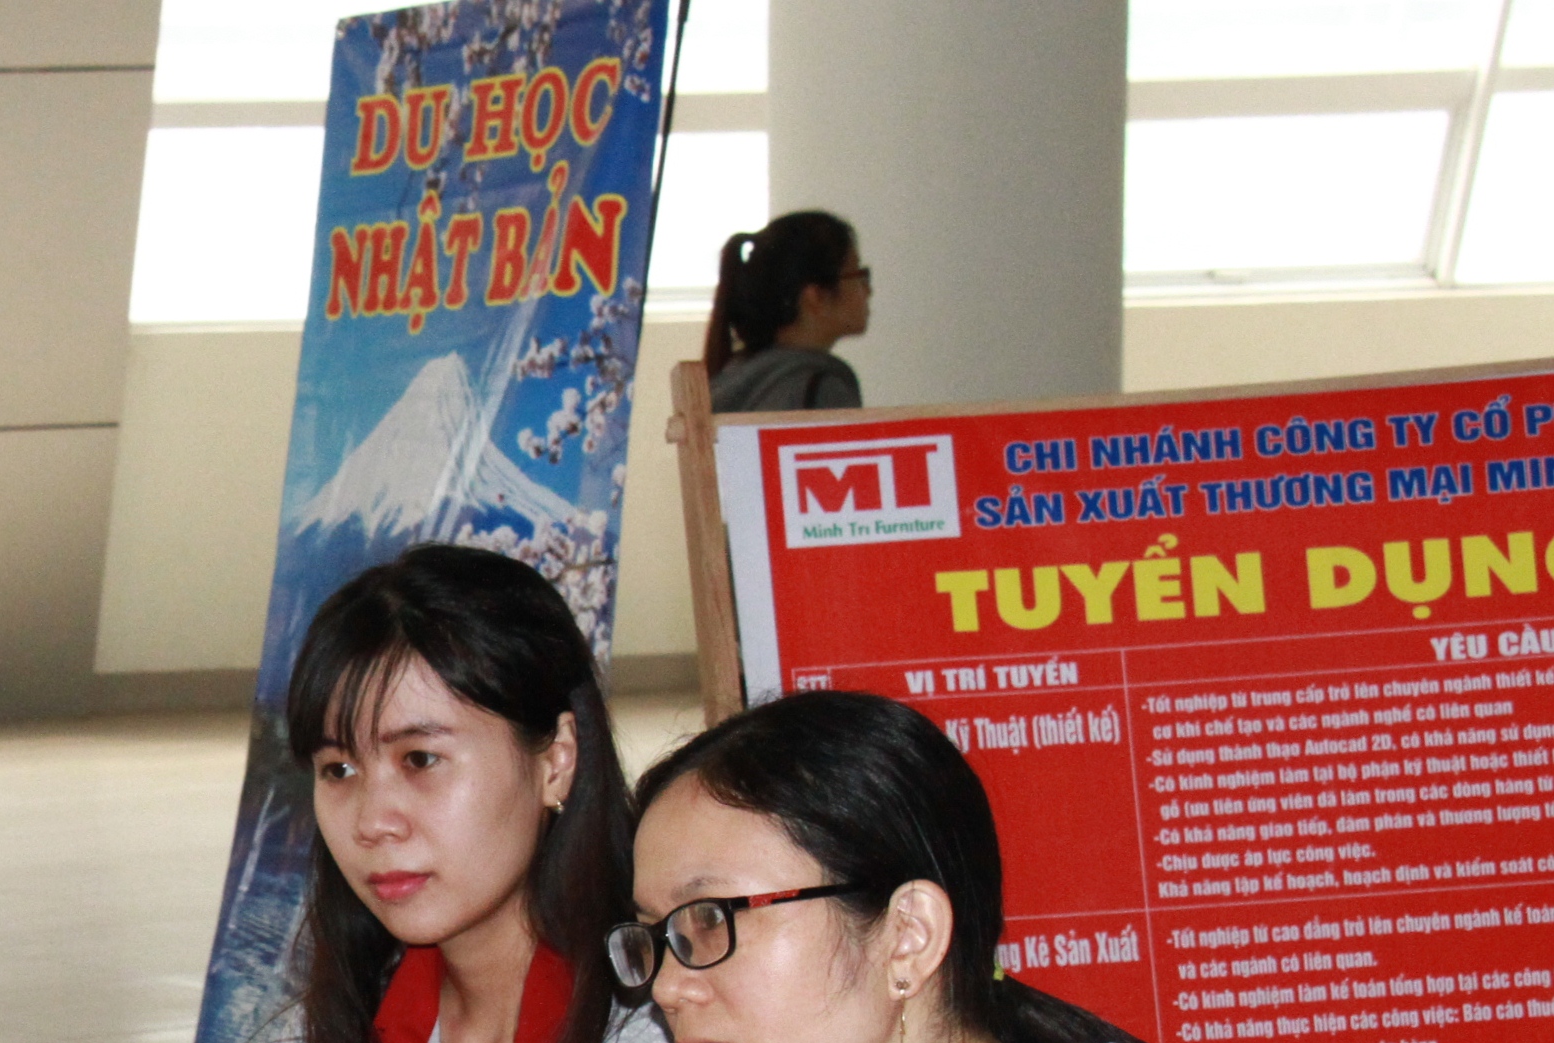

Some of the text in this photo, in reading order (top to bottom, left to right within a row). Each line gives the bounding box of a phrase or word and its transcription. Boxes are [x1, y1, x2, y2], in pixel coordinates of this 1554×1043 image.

[351, 57, 621, 176] DU HỌC
[325, 159, 628, 334] NHẬT BẢN
[1004, 438, 1079, 474] CHI
[1089, 425, 1242, 470] NHÁNH
[1255, 416, 1375, 457] CÔNG
[1388, 413, 1439, 448] TY
[1452, 394, 1512, 442] CỔ
[794, 443, 938, 515] MT
[974, 485, 1065, 528] SẢN
[1078, 475, 1189, 523] XUẤT
[1200, 471, 1375, 515] THƯƠNG
[1388, 462, 1474, 505] MẠI
[802, 523, 844, 540] Minh
[874, 518, 946, 536] Furniture
[935, 530, 1554, 632] TUYỂN DỤN
[905, 670, 935, 696] VỊ
[942, 663, 987, 692] TRÍ
[993, 655, 1079, 689] TUYỂN
[1430, 632, 1489, 661] YÊU
[974, 715, 1028, 754] Thuật
[1024, 924, 1140, 969] Kê Sản Xuất
